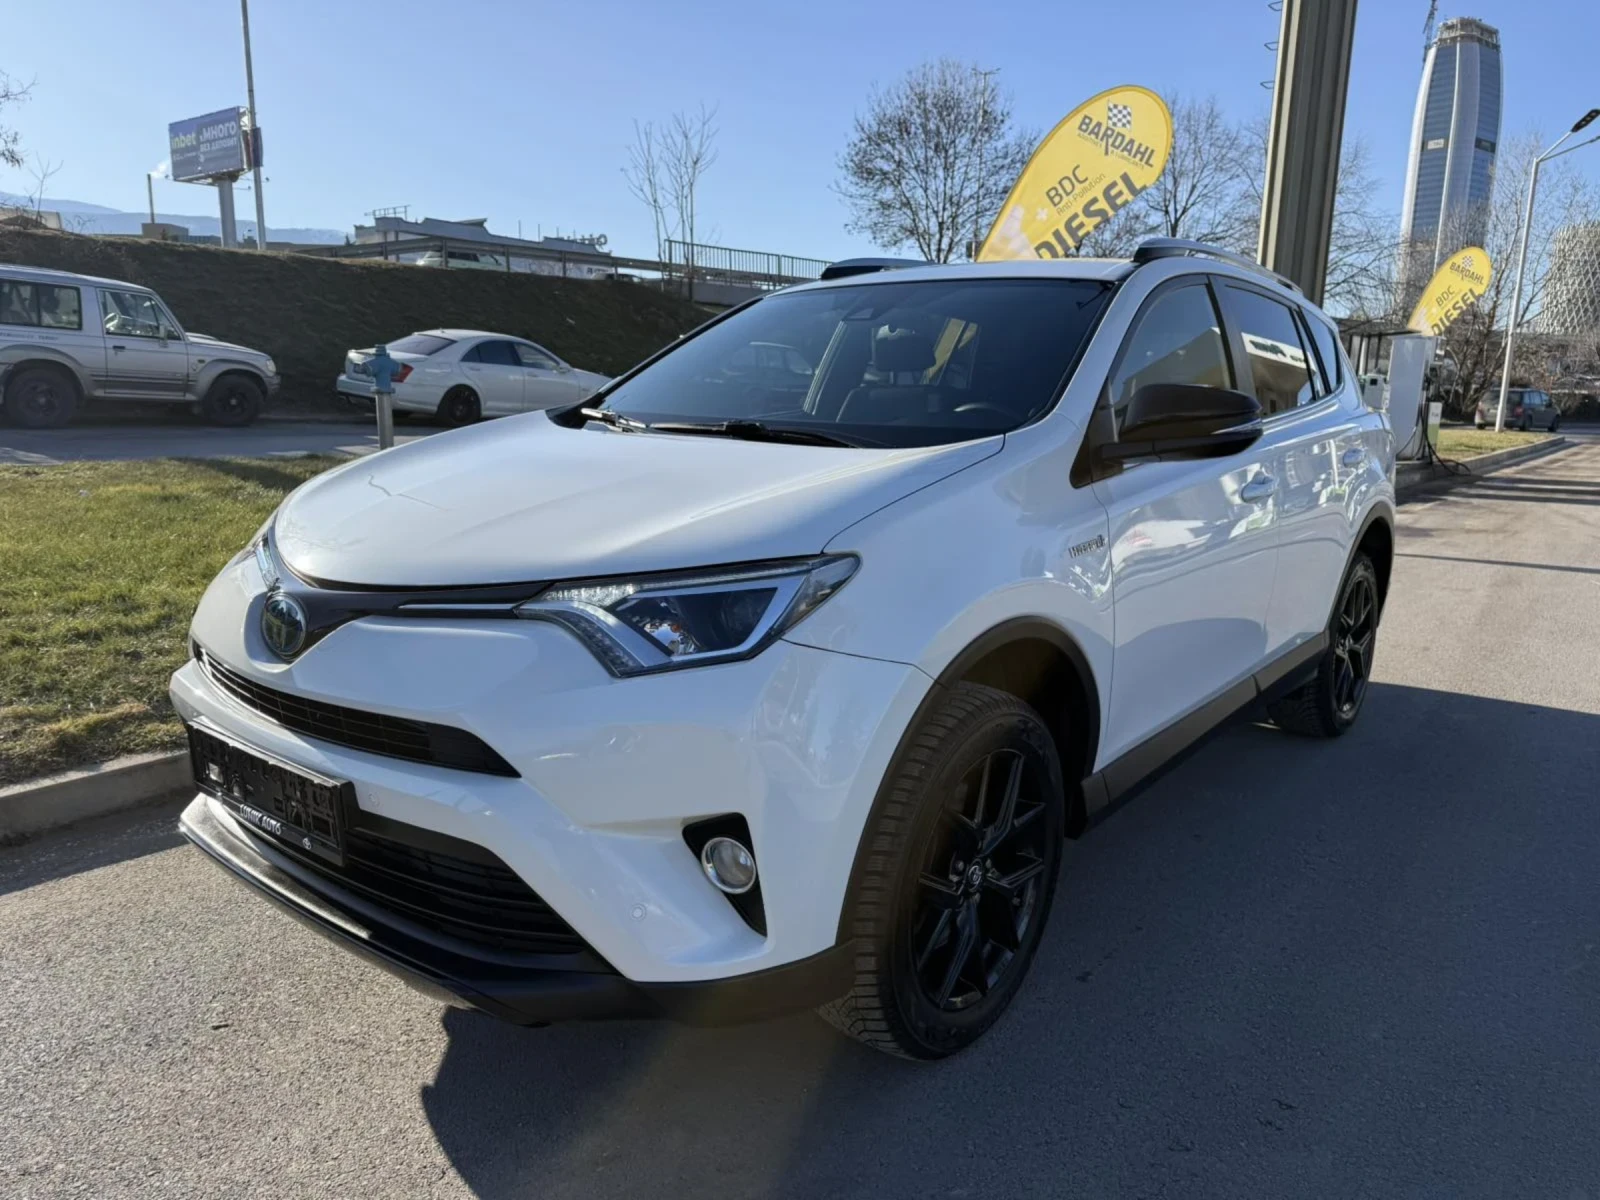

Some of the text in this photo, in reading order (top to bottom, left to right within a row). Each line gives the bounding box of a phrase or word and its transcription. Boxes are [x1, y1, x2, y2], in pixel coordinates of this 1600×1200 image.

[1077, 114, 1156, 168] BARDAHL
[1046, 164, 1089, 207] BDC
[1034, 172, 1147, 259] DIESEL
[1435, 285, 1456, 307] BDC
[1450, 262, 1484, 285] BARDAHL
[1431, 288, 1479, 336] DIESEL
